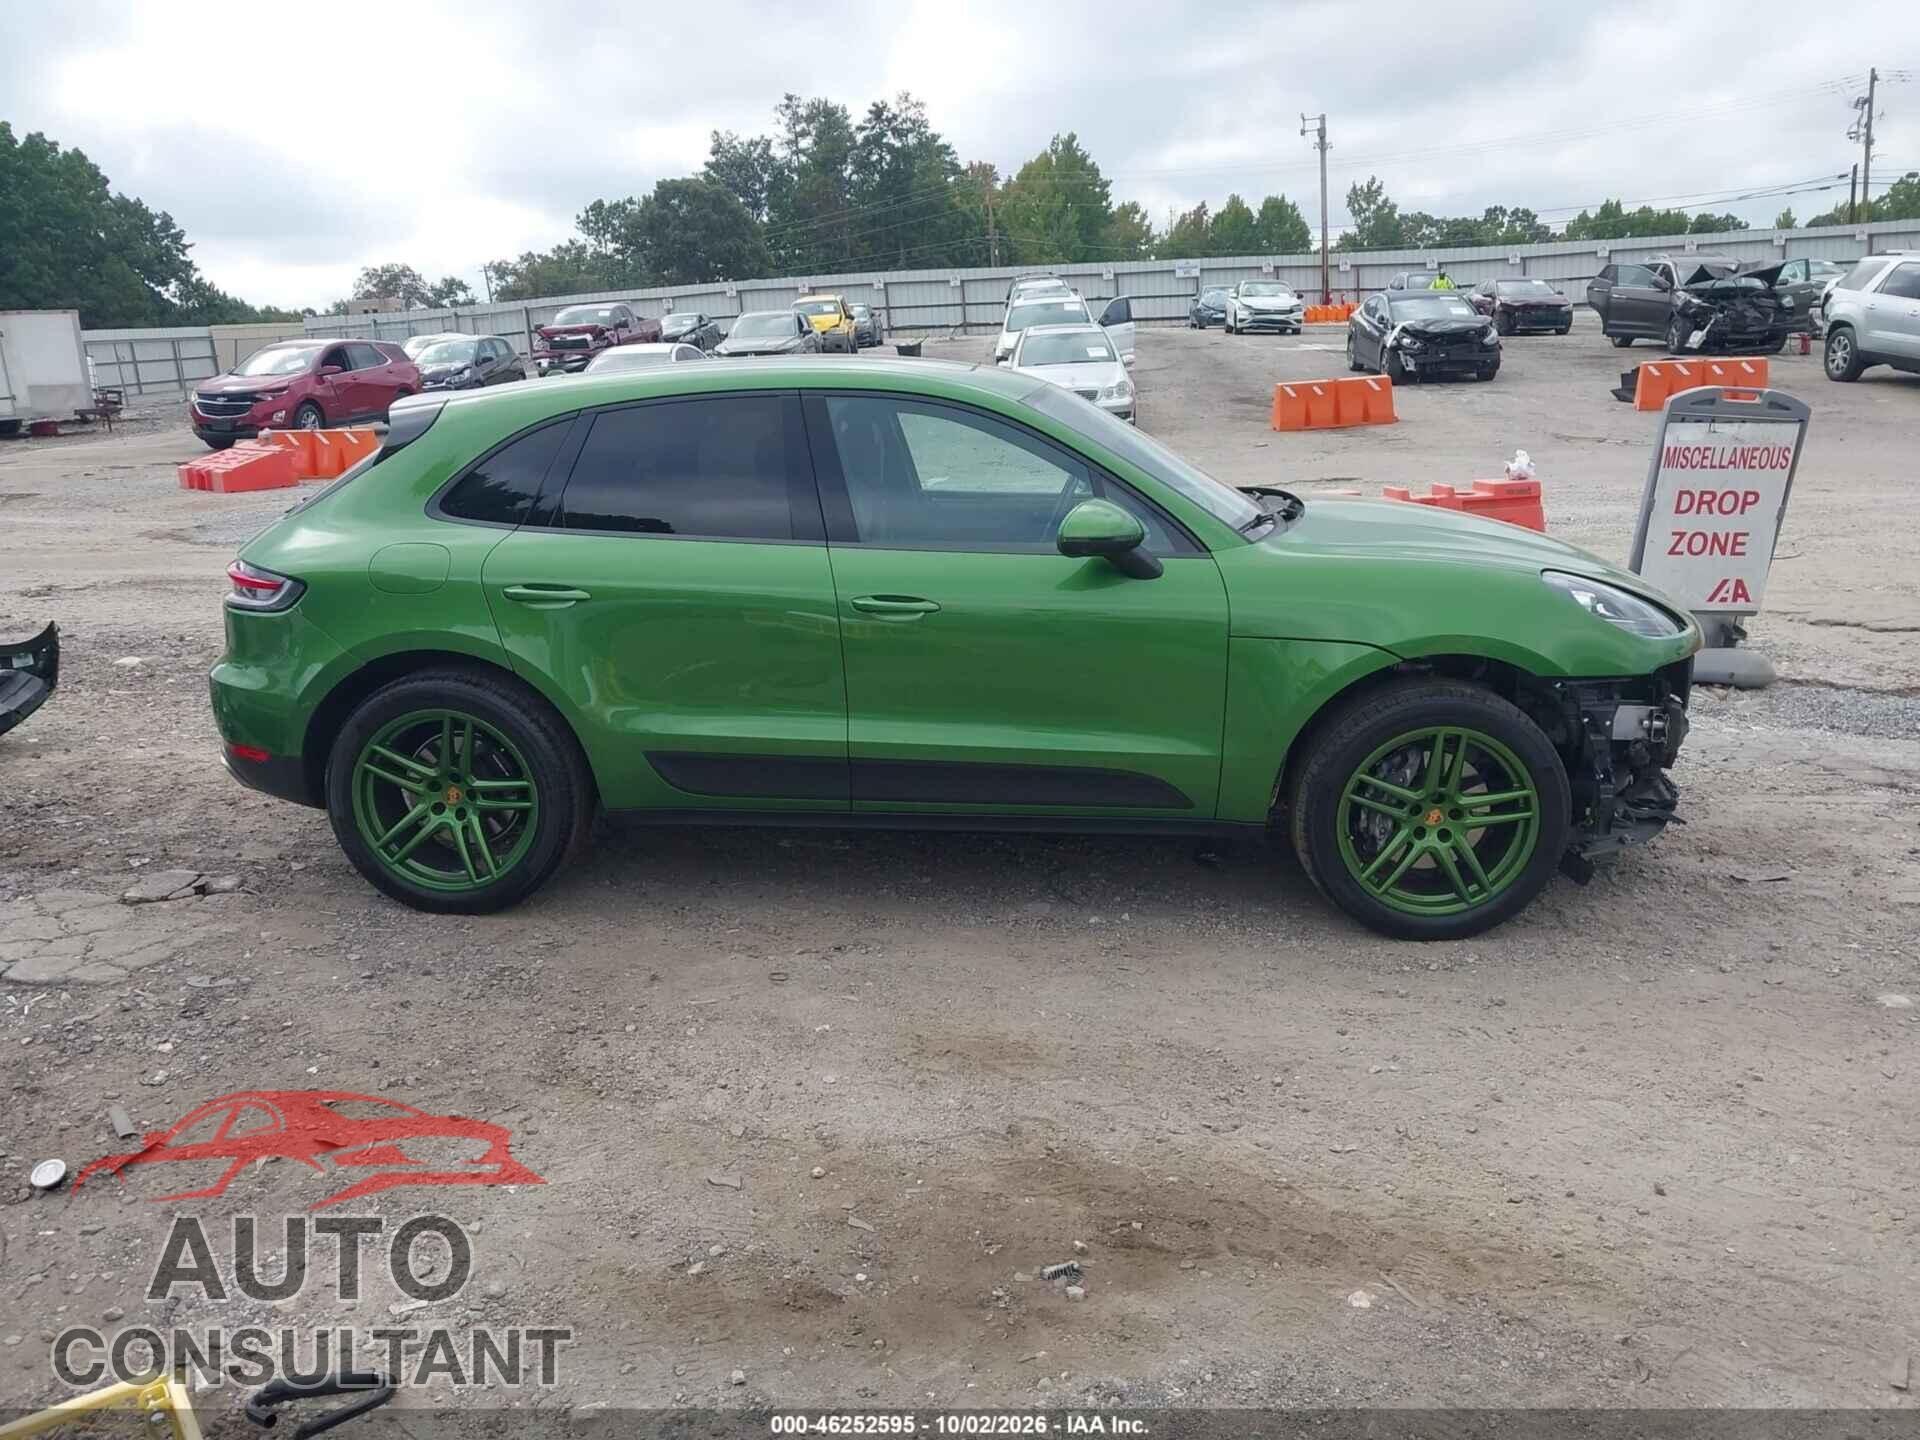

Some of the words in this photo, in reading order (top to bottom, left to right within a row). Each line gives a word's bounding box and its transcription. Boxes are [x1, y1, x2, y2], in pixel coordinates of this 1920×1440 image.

[1663, 446, 1791, 469] MISCELLANEOUS
[1674, 490, 1760, 515] DROP
[1667, 531, 1750, 556] ZONE
